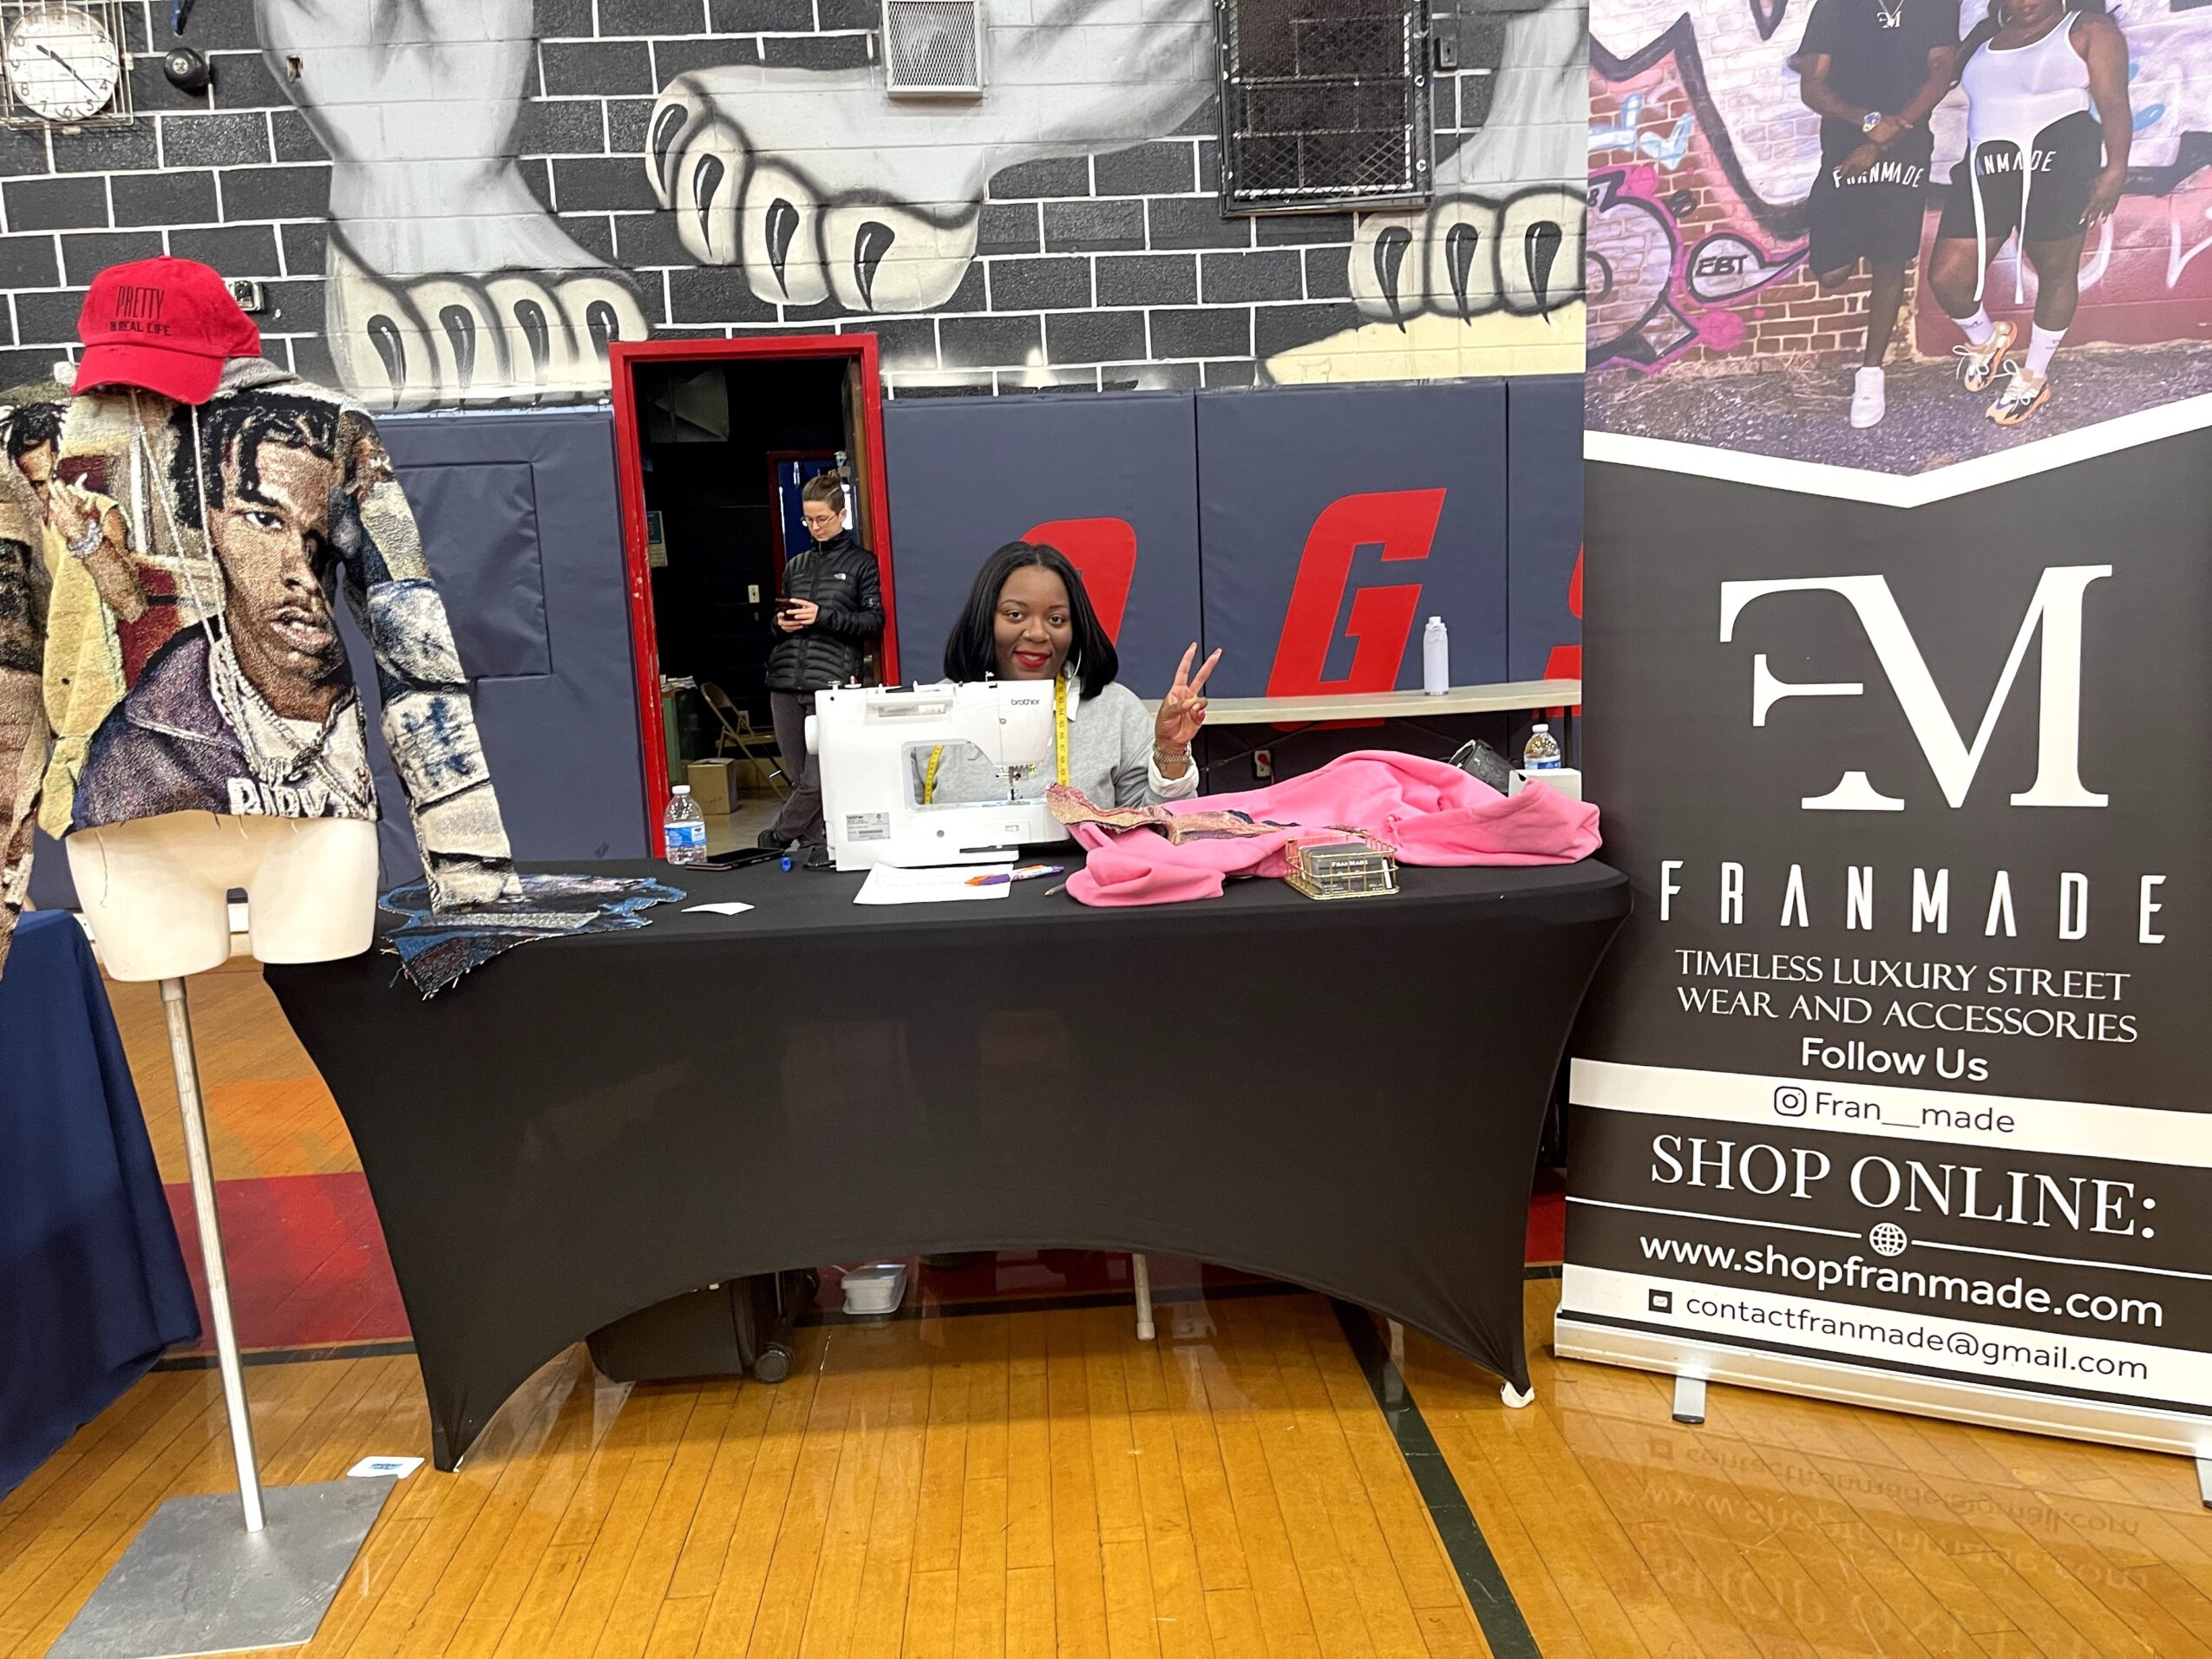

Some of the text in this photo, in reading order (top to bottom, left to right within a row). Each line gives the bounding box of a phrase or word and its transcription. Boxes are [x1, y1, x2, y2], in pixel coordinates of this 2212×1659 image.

[21, 82, 29, 96] 8
[1832, 160, 1924, 188] FNMADE
[115, 286, 165, 320] PRETTY
[118, 321, 144, 332] REAL
[147, 323, 172, 337] LIFE
[1660, 859, 2168, 944] FRANMADE
[1675, 950, 2131, 1002] TIMELESS LUXURY STREET
[1677, 987, 2138, 1043] WEAR AND ACCESSORIES
[1802, 1037, 1990, 1082] Follow Us
[1651, 1134, 2156, 1239] SHOP ONLINE:
[1639, 1235, 2163, 1327] www.shopfranmade.com
[1686, 1296, 2149, 1381] contactfranmade@gmail.com
